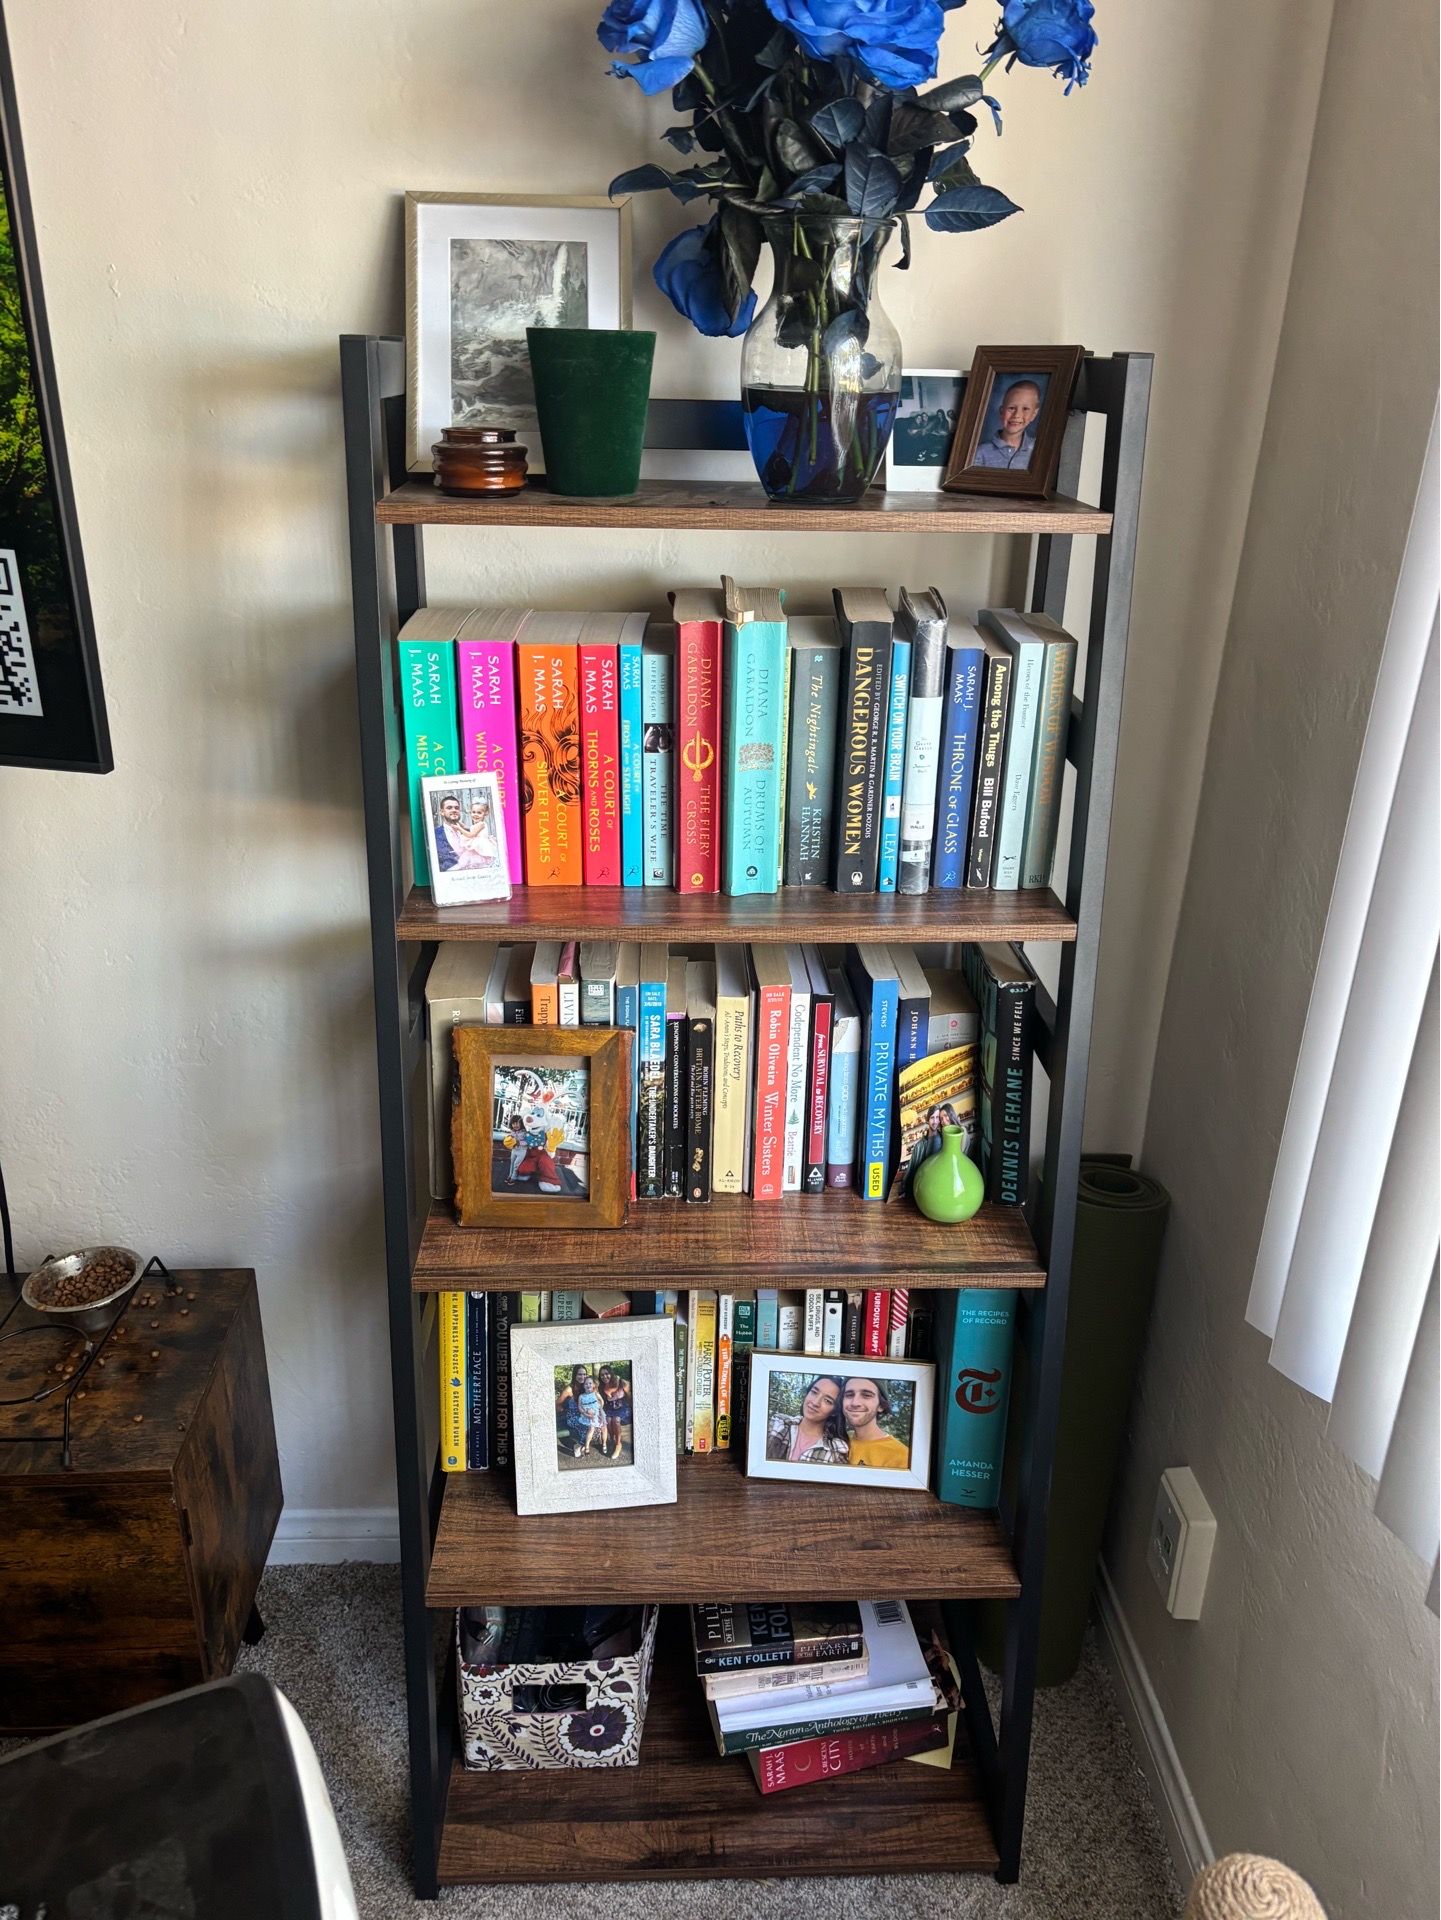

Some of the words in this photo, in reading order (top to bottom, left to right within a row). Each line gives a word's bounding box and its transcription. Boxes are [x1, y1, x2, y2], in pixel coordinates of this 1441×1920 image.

[407, 648, 421, 658] J.
[469, 651, 482, 660] J.
[532, 655, 545, 664] J.
[584, 655, 597, 664] J.
[410, 662, 425, 707] MAAS
[427, 652, 442, 704] SARAH
[472, 665, 485, 709] MAAS
[488, 655, 501, 705] SARAH
[535, 669, 547, 713] MAAS
[551, 657, 564, 709] SARAH
[602, 659, 613, 710] SARAH
[624, 662, 632, 689] MAAS
[687, 642, 697, 727] GABALDON
[700, 658, 711, 708] DIANA
[811, 675, 823, 697] The
[875, 664, 883, 689] EDITED
[954, 674, 965, 703] MAAS
[966, 665, 977, 701] SARAH
[989, 664, 1007, 707] Among
[1048, 648, 1067, 711] WOMEN
[586, 670, 598, 714] MAAS
[745, 653, 756, 736] GABALDON
[757, 669, 769, 718] DIANA
[893, 674, 906, 710] SWITCH
[849, 646, 875, 775] DANGEROUS
[872, 702, 881, 729] GEORGE
[892, 711, 904, 725] ON
[991, 709, 1003, 728] the
[1020, 704, 1029, 728] Frontier
[416, 734, 429, 766] MIST
[623, 719, 632, 749] FROST
[805, 703, 821, 774] Nightingale
[891, 725, 903, 750] YOUR
[986, 731, 1001, 767] Thugs
[587, 730, 599, 787] THORNS
[604, 754, 614, 764] A
[633, 752, 641, 783] COURT
[869, 746, 878, 772] MARTIN
[889, 752, 902, 780] BRAIN
[949, 733, 967, 791] THRONE
[536, 760, 549, 805] SILVER
[604, 770, 615, 817] COURT
[623, 766, 632, 815] STARLIGHT
[649, 759, 657, 831] TRAVELER'S
[660, 783, 668, 803] THE
[866, 779, 875, 811] GARDNER
[983, 777, 995, 796] Bill
[700, 785, 711, 816] THE
[754, 779, 766, 830] DRUMS
[949, 796, 958, 808] OF
[556, 804, 568, 847] COURT
[590, 808, 601, 852] ROSES
[660, 807, 668, 839] TIME
[687, 800, 697, 845] CROSS
[743, 787, 753, 850] AUTUMN
[800, 806, 811, 860] HANNAH
[811, 808, 822, 858] KRISTIN
[844, 782, 865, 854] WOMEN
[864, 813, 874, 838] DOZOIS
[945, 812, 959, 853] GLASS
[979, 799, 992, 837] Buford
[538, 811, 551, 863] FLAMES
[649, 834, 657, 862] WIFE
[699, 819, 710, 857] FIERY
[754, 836, 764, 854] OF
[884, 833, 896, 862] LEAF
[734, 1010, 746, 1032] Paths
[769, 1010, 782, 1039] Robin
[880, 1000, 889, 1028] STEVENS
[1014, 1000, 1023, 1019] FELL
[650, 1014, 661, 1040] SARA
[734, 1034, 742, 1042] to
[790, 1004, 806, 1061] Codependent
[910, 1010, 919, 1049] JOHANN
[1013, 1021, 1022, 1036] WE
[649, 1042, 661, 1081] BLAEDEL
[729, 1044, 743, 1081] Recovery
[767, 1043, 780, 1086] Oliveira
[1012, 1037, 1020, 1061] SINCE
[792, 1064, 804, 1078] No
[815, 1049, 826, 1086] SURVIVAL
[874, 1042, 890, 1102] PRIVATE
[649, 1086, 657, 1098] THE
[695, 1083, 703, 1109] AFTER
[790, 1080, 802, 1103] More
[1004, 1068, 1023, 1133] LEHANE
[648, 1099, 657, 1144] UNDERTAKER'S
[694, 1111, 702, 1135] ROME
[763, 1090, 779, 1132] Winter
[813, 1095, 823, 1135] RECOVERY
[786, 1131, 798, 1157] Beattie
[871, 1108, 886, 1157] MYTHS
[647, 1145, 656, 1178] DAUGHTER
[761, 1136, 777, 1176] Sisters
[1001, 1140, 1019, 1202] DENNIS
[871, 1167, 880, 1191] USED
[872, 1292, 881, 1328] FURIOUSLY
[497, 1316, 508, 1339] YOU
[871, 1330, 879, 1353] HAPPY
[497, 1342, 508, 1373] WERE
[703, 1341, 713, 1366] HARRY
[473, 1350, 482, 1424] MOTHERPEACE
[497, 1375, 508, 1405] BORN
[702, 1368, 713, 1397] POTTER
[954, 1367, 1002, 1415] T
[497, 1407, 508, 1429] FOR
[497, 1431, 508, 1454] THIS
[949, 1459, 994, 1470] AMANDA
[951, 1469, 991, 1480] HESSER
[725, 1633, 733, 1642] OF
[800, 1643, 847, 1652] PILLARS
[816, 1647, 850, 1657] EARTH
[718, 1656, 741, 1667] KEN
[745, 1651, 792, 1664] FOLLETT
[746, 1732, 766, 1742] The
[766, 1727, 804, 1739] Norton
[805, 1717, 859, 1734] Anthology
[774, 1751, 786, 1784] MAAS
[828, 1740, 841, 1771] CITY
[766, 1760, 775, 1788] SARAH
